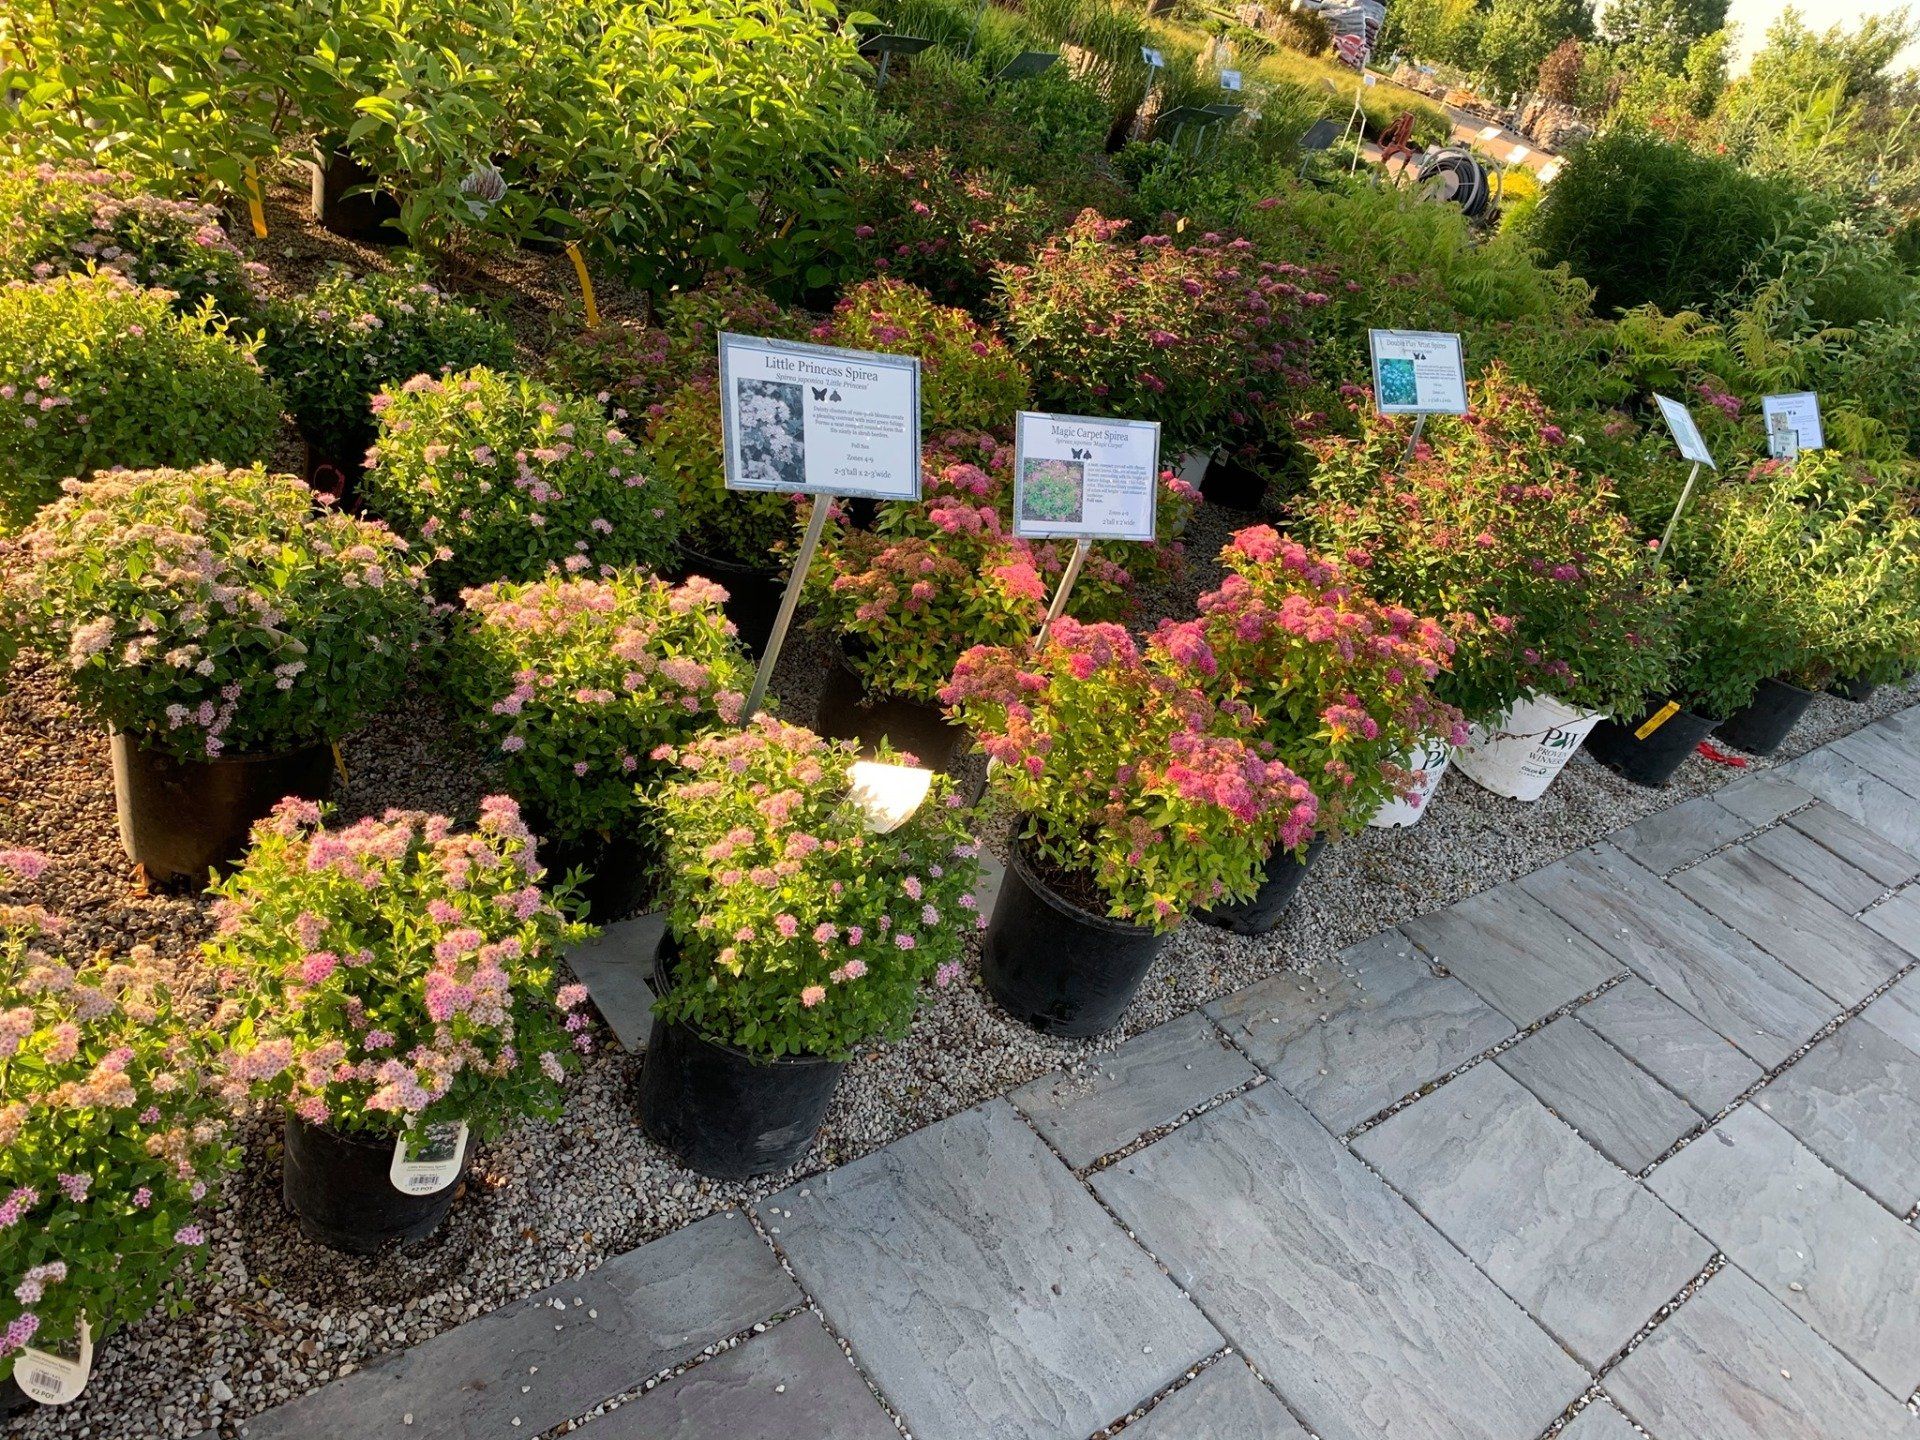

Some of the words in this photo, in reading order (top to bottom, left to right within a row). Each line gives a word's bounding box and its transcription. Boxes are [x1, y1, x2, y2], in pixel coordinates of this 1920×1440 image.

[765, 356, 794, 371] Little
[798, 360, 843, 377] Princess
[845, 366, 878, 382] Spirea
[1051, 425, 1075, 438] Magic
[1077, 428, 1102, 441] Carpet
[1104, 430, 1129, 442] Spirea
[41, 1392, 55, 1400] POT
